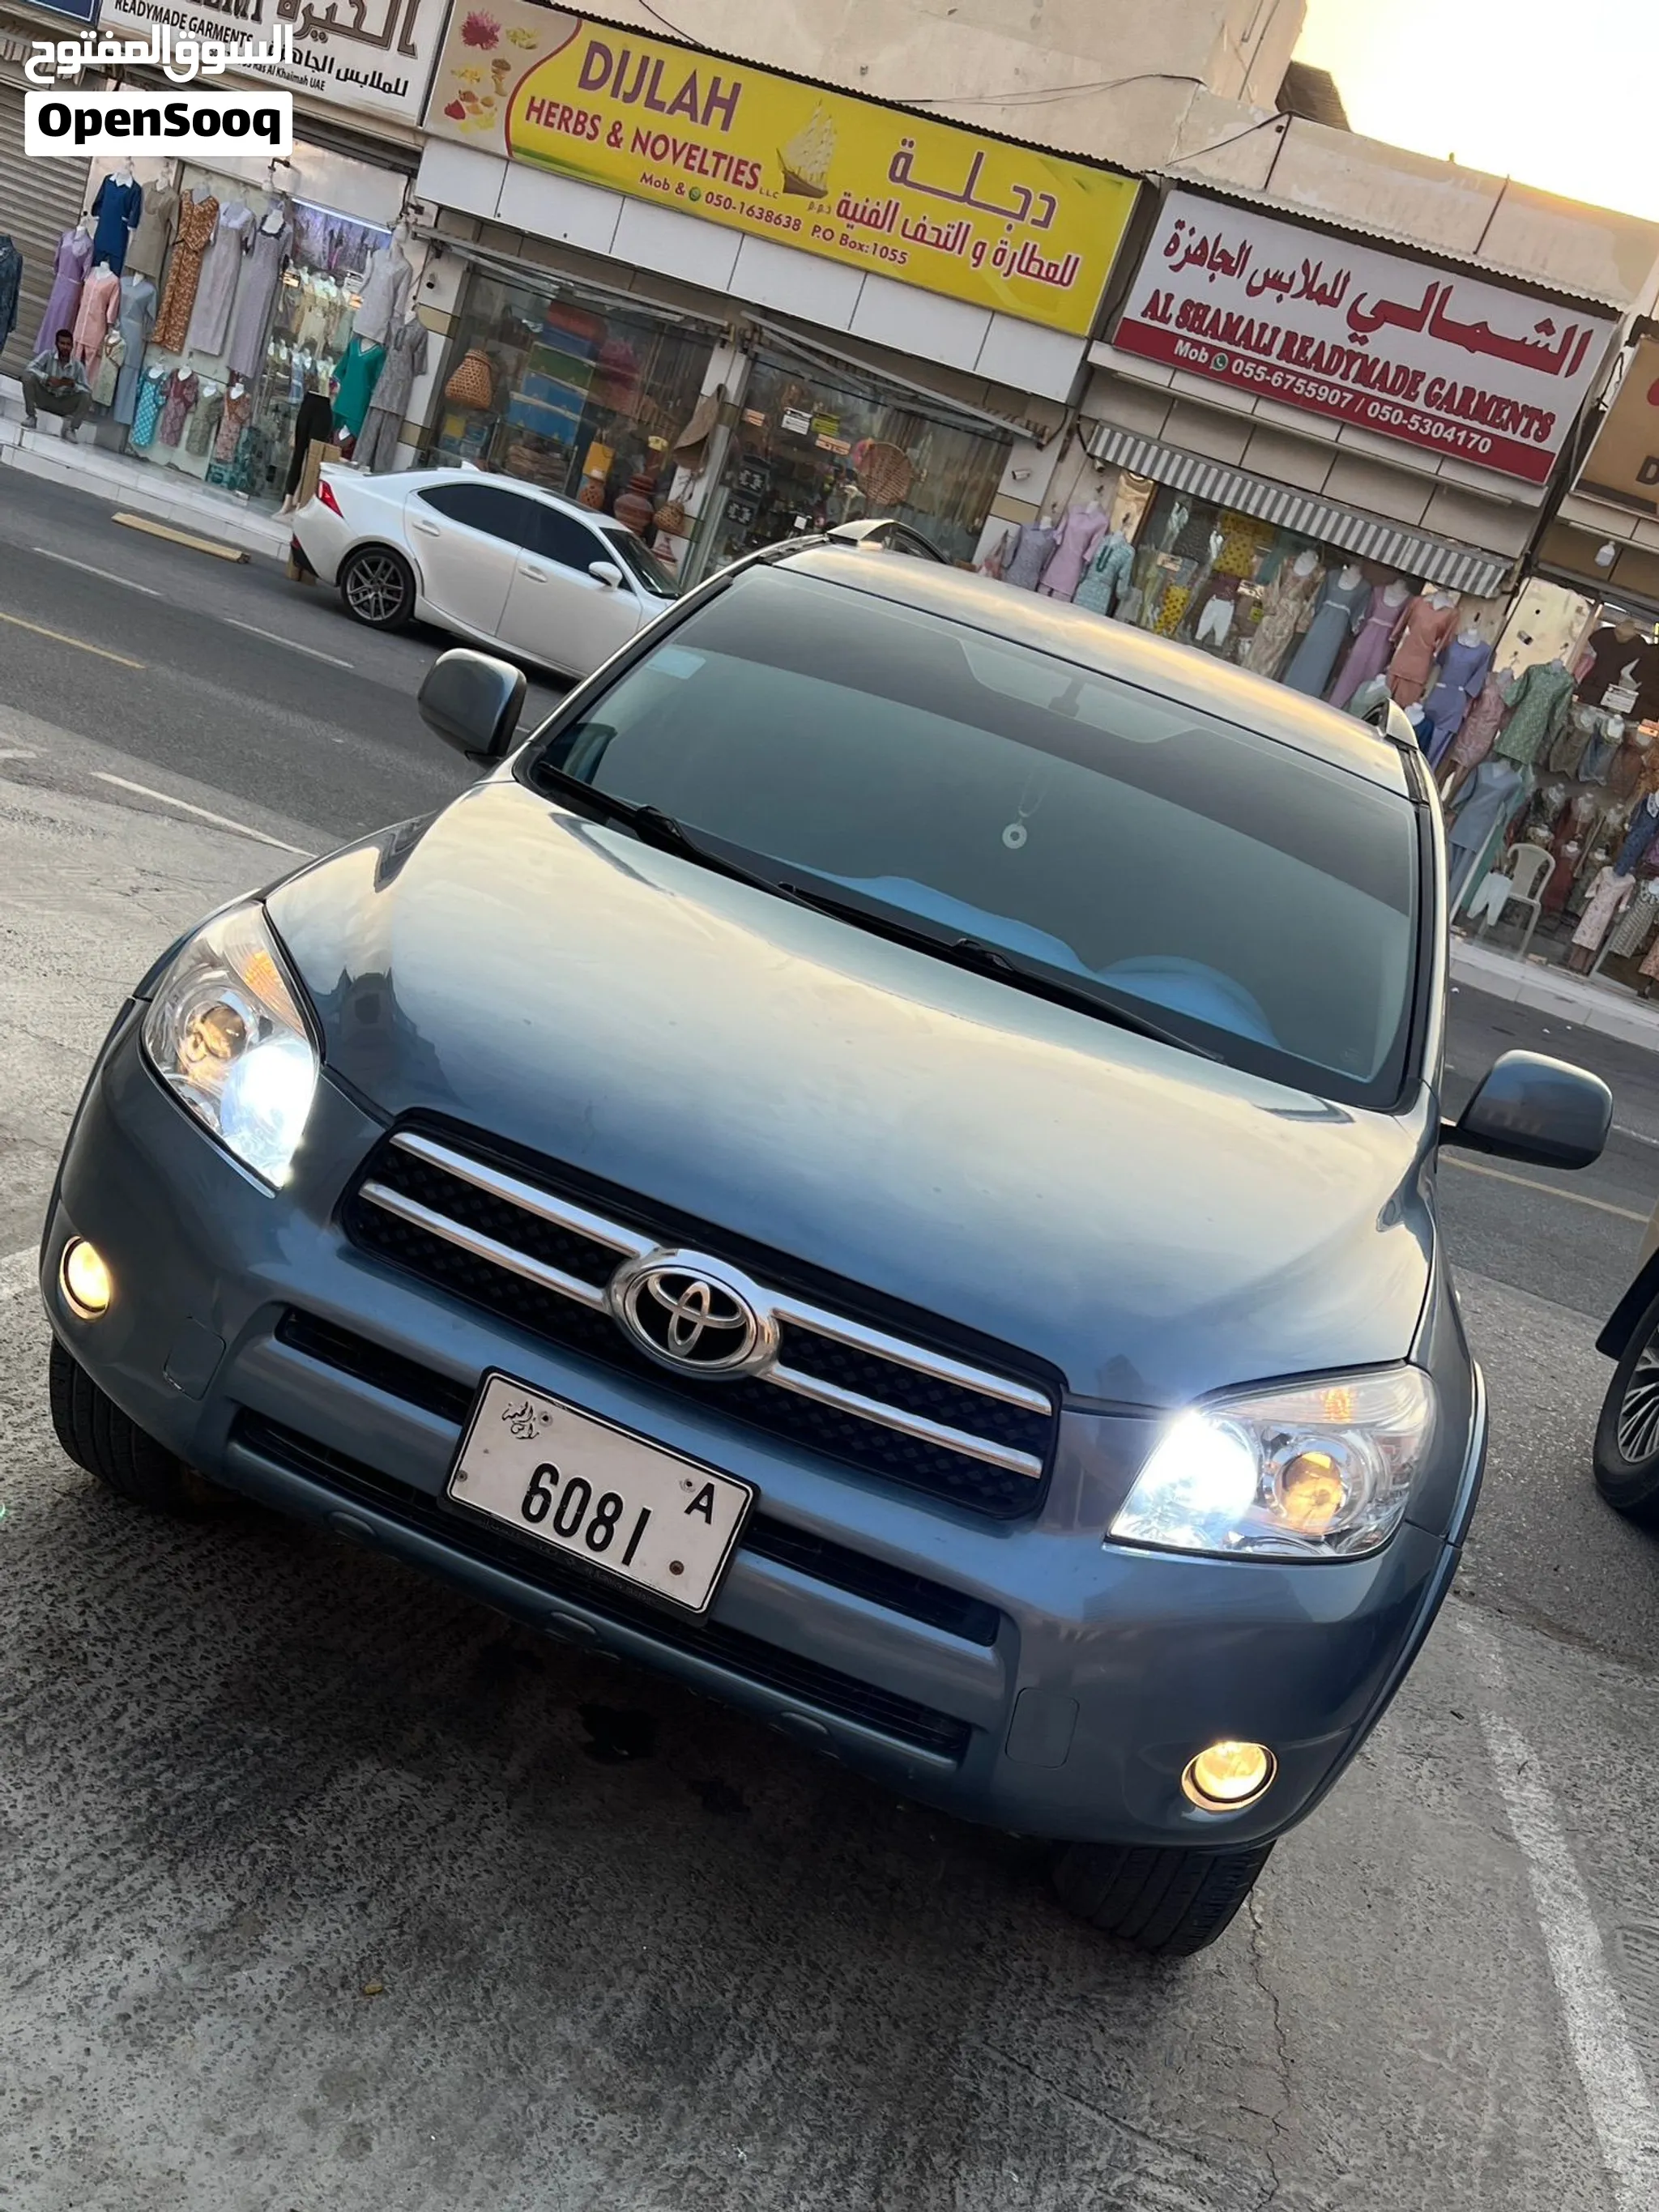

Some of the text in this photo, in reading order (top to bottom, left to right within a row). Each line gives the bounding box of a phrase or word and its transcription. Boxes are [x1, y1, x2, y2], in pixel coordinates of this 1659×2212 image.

[276, 68, 308, 85] Khaimah
[309, 78, 326, 91] UAE
[335, 66, 408, 96] للملابس
[578, 40, 742, 132] DIJLAH
[525, 96, 602, 140] HERBS
[607, 121, 624, 148] &
[630, 126, 762, 191] NOVELTIES
[640, 172, 670, 190] Mob
[675, 182, 685, 196] &
[705, 192, 802, 232] 050-1638638
[836, 192, 900, 232] الفنية
[889, 138, 1057, 232] دجلة
[901, 215, 970, 255] التحف
[972, 241, 987, 267] و
[992, 240, 1080, 287] للعطارة
[1163, 219, 1593, 377] الشمالي للملابس الجاهزة
[1141, 289, 1556, 442] AL SHAMALI READYMADE GARMENTS
[1175, 339, 1209, 364] Mob
[1231, 359, 1354, 408] 055-6755907
[1367, 401, 1492, 454] 050-5304170
[521, 1463, 652, 1566] 6081
[684, 1482, 714, 1524] A
